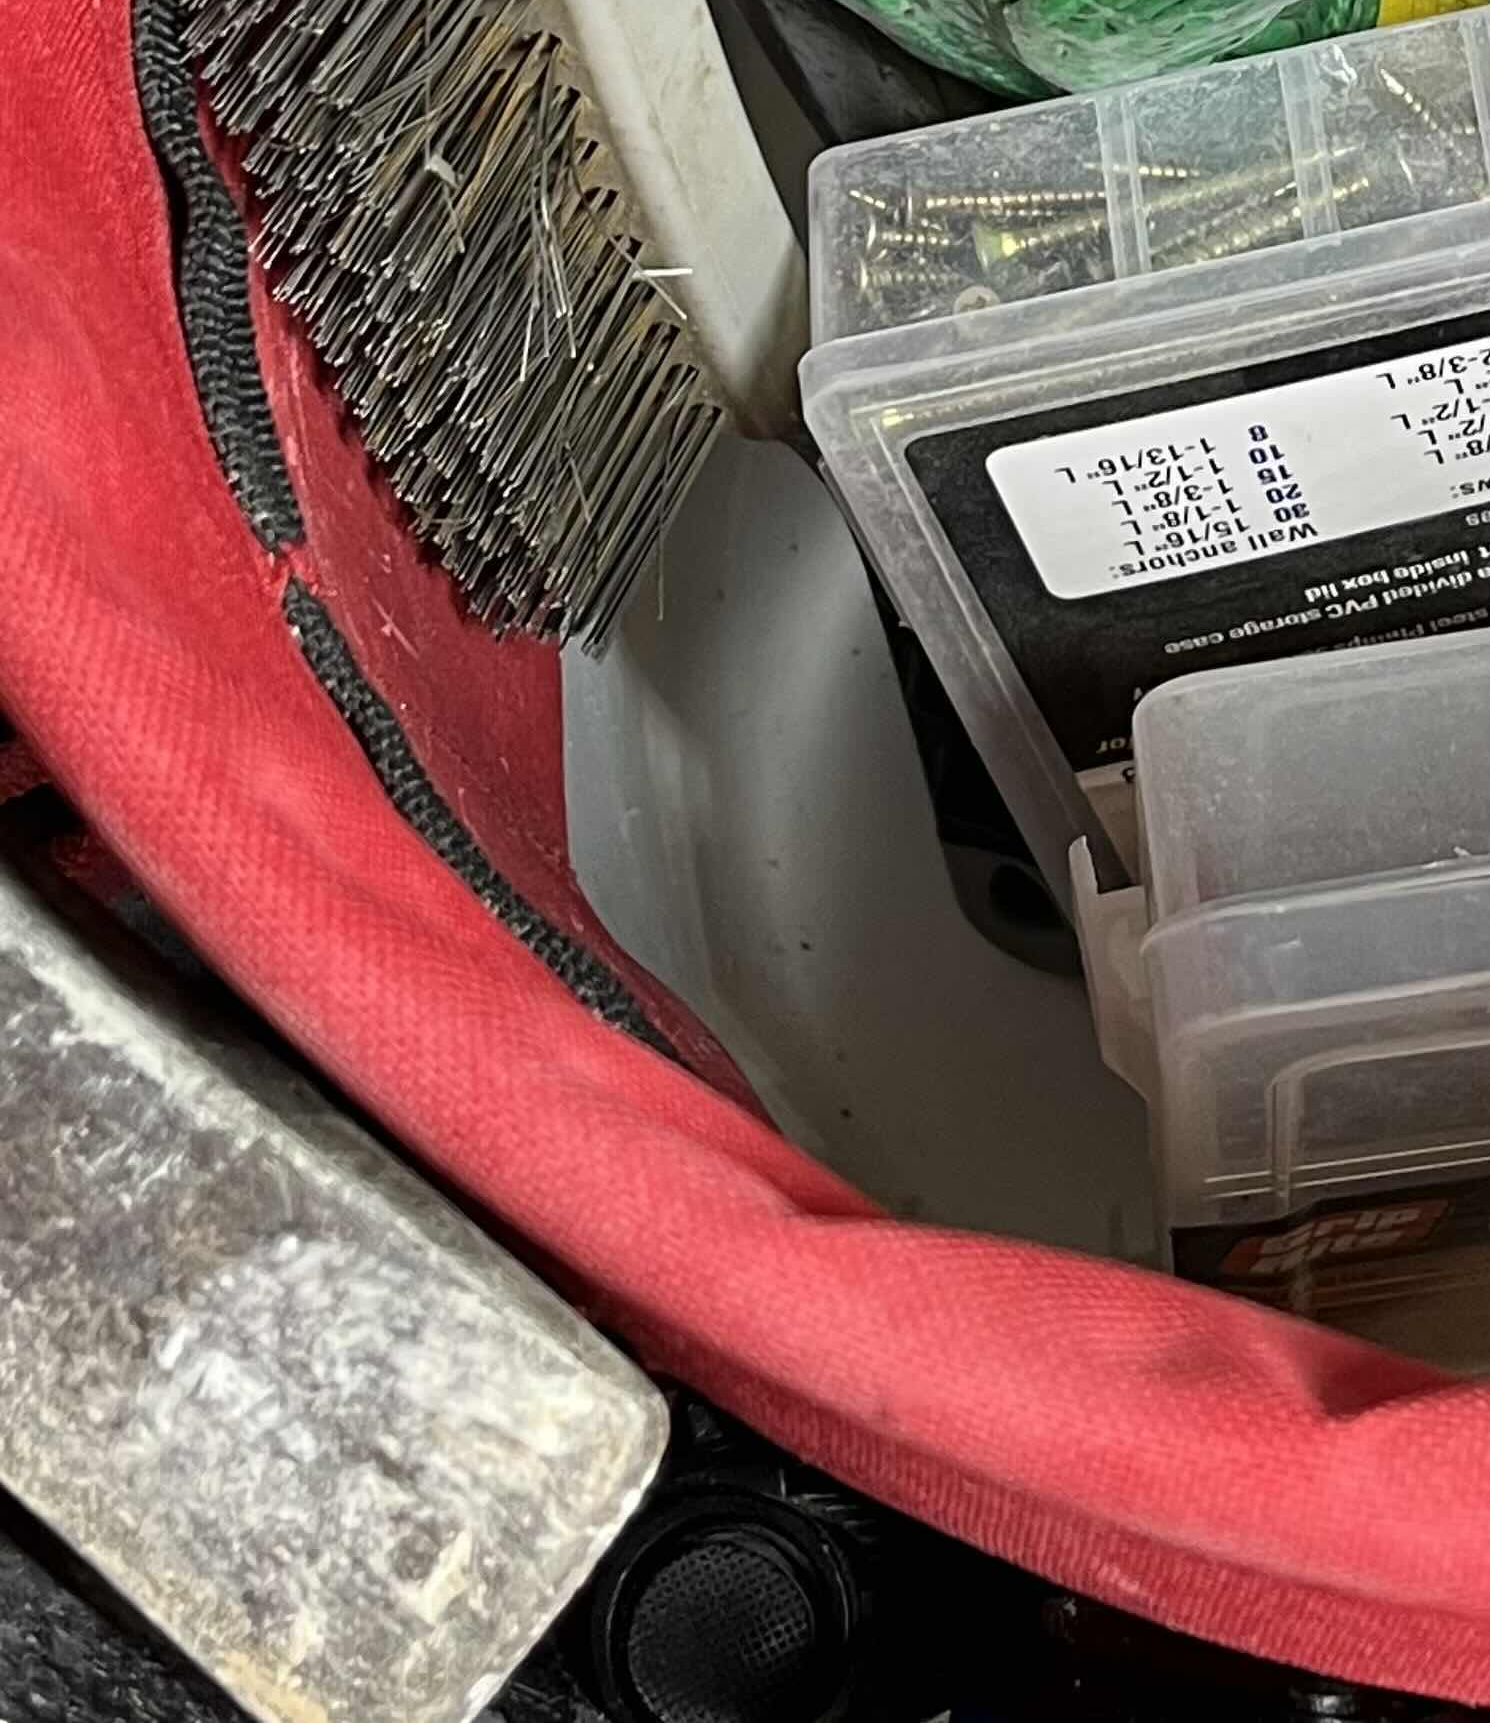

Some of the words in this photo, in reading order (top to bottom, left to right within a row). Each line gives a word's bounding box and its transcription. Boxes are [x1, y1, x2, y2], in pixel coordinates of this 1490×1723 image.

[1376, 371, 1397, 391] L
[1443, 377, 1465, 396] L
[1390, 412, 1412, 431] L
[1247, 424, 1270, 443] 8
[1417, 428, 1438, 446] L
[1247, 443, 1286, 466] 10
[1425, 448, 1445, 466] L
[1056, 466, 1077, 485] L
[1256, 463, 1293, 486] 15
[1102, 479, 1125, 497] L
[1264, 482, 1303, 505] 20
[1111, 498, 1134, 517] L
[1272, 502, 1311, 524] 30
[1120, 519, 1143, 537] L
[1246, 521, 1319, 552] Wall
[1109, 539, 1239, 579] anchors:
[1123, 539, 1146, 557] L
[1392, 549, 1470, 581] inside
[1340, 568, 1391, 591] box
[1381, 570, 1474, 606] divided
[1303, 582, 1340, 604] lid
[1323, 593, 1380, 620] PVC
[1228, 607, 1323, 640] storage
[1163, 631, 1226, 655] case
